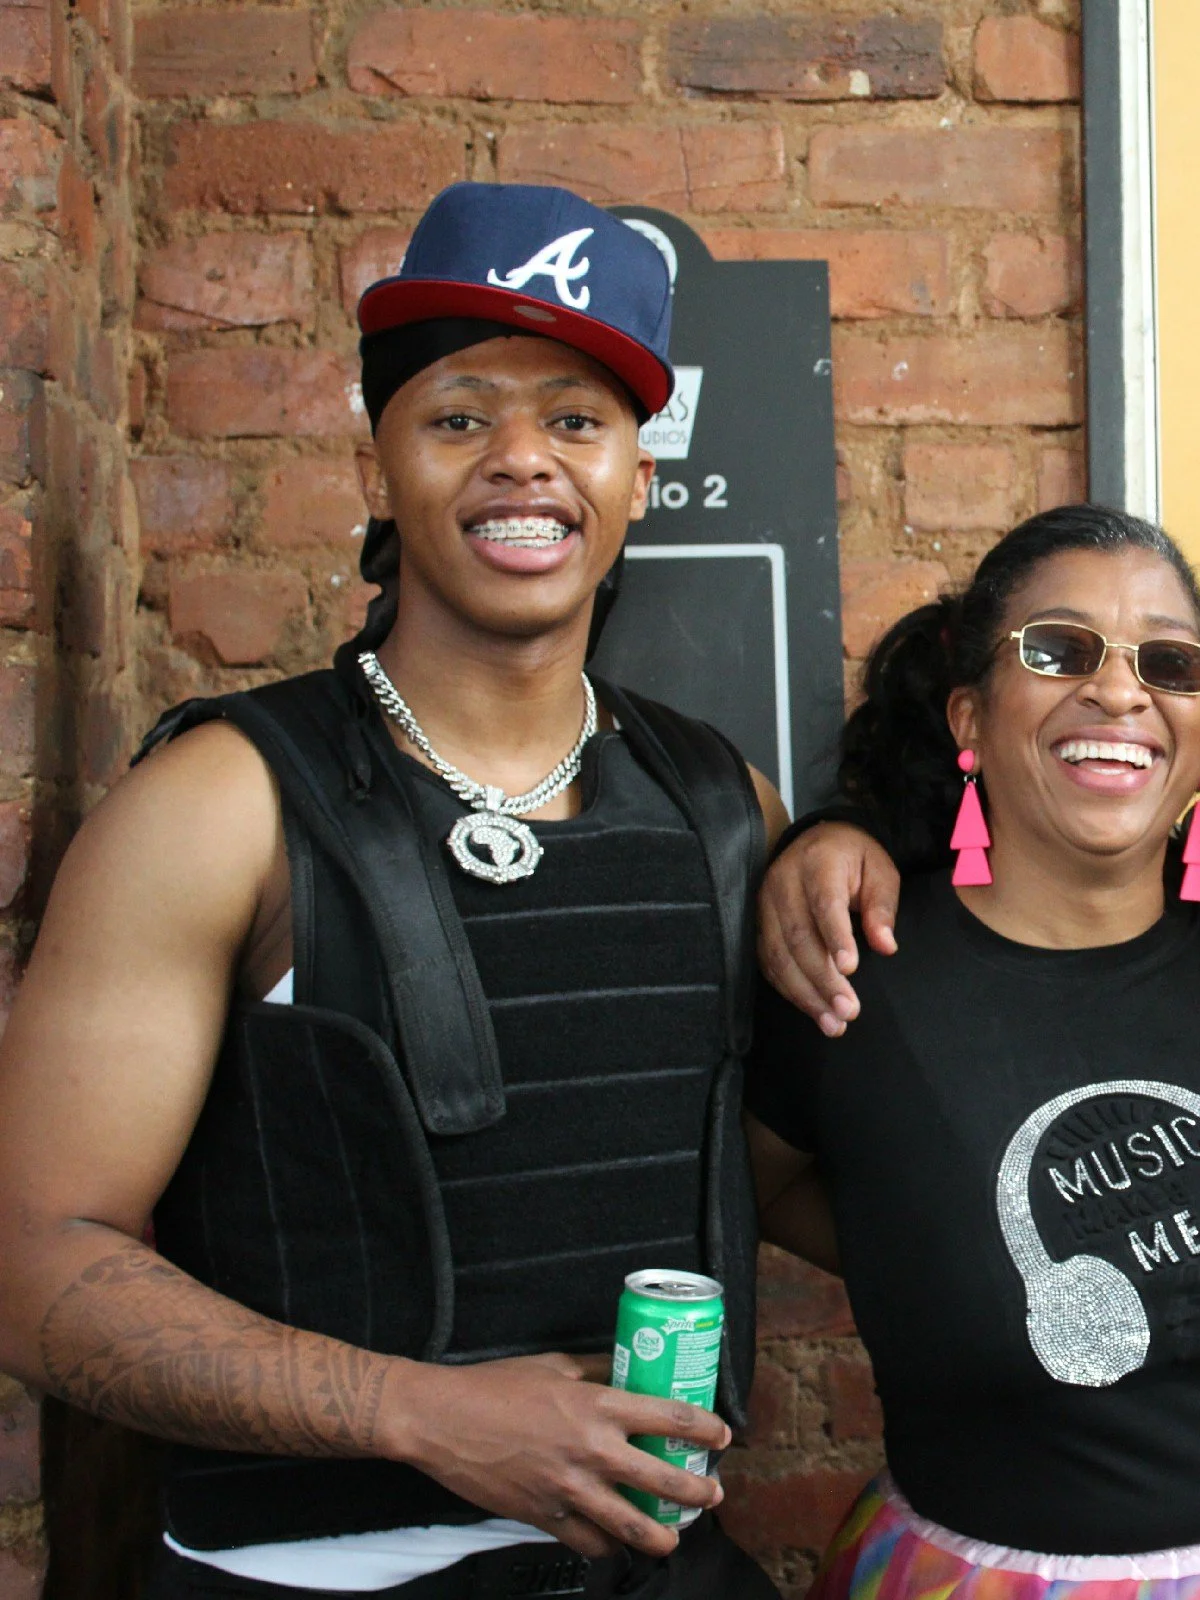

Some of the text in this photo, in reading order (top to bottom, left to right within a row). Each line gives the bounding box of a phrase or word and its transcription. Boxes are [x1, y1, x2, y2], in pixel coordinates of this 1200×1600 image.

[487, 227, 595, 311] A
[654, 391, 690, 423] AS
[640, 429, 689, 446] UDIOS
[648, 474, 729, 510] io 2
